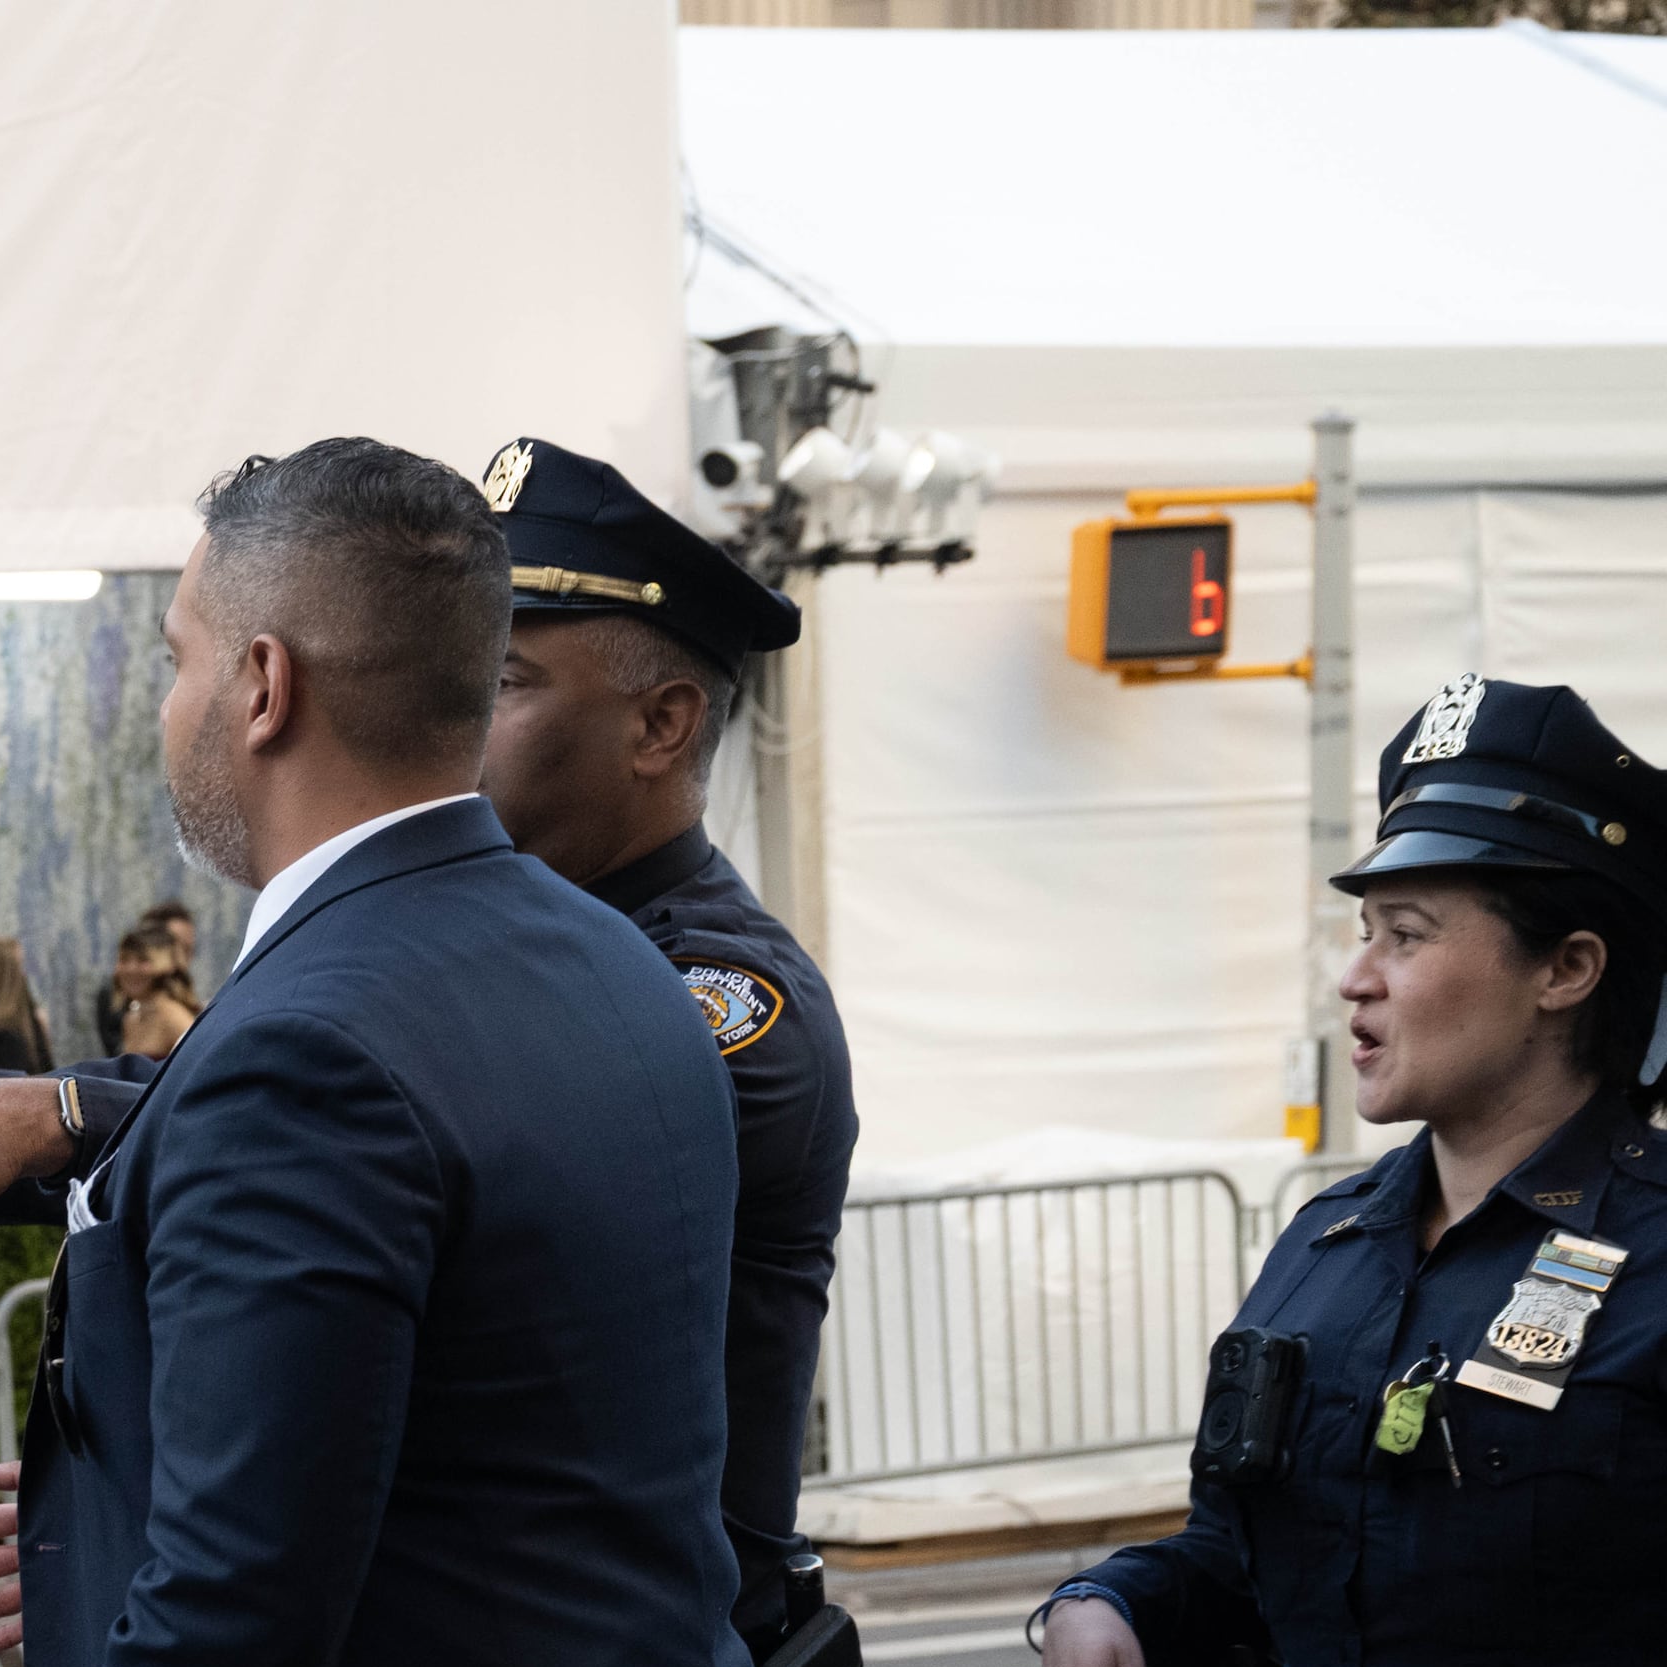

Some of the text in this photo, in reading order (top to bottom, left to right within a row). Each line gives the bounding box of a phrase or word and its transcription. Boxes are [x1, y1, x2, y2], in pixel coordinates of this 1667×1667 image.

[720, 1019, 758, 1044] YORK
[1495, 1323, 1571, 1363] 13824
[1486, 1371, 1534, 1397] STEWART
